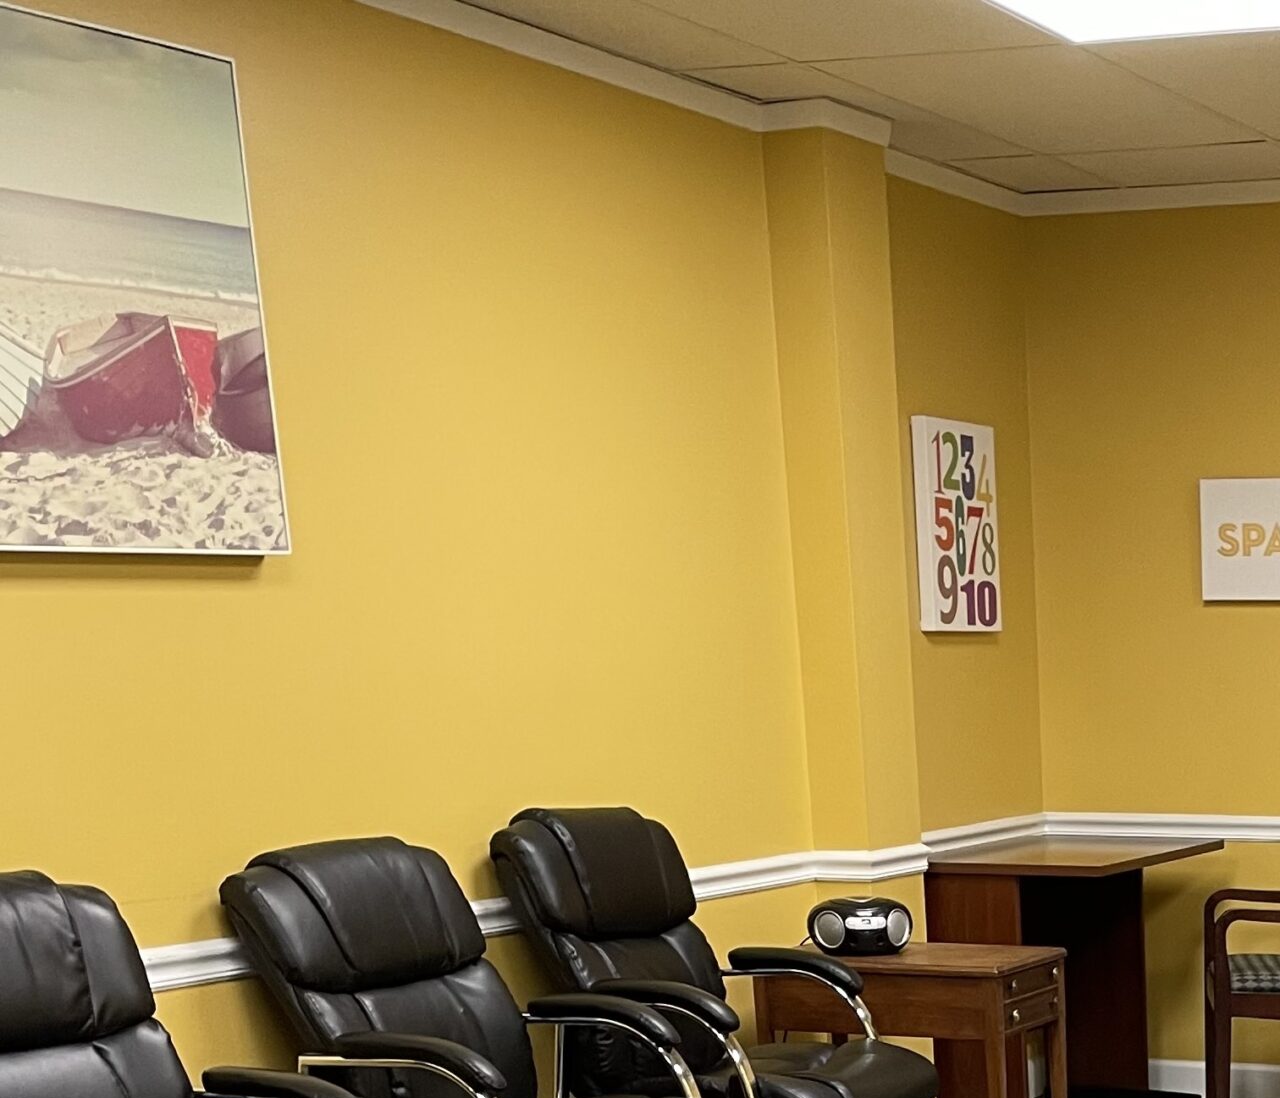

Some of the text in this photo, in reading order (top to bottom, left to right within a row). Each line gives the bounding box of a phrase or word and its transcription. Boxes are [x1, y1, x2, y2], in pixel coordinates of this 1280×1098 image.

[931, 430, 993, 517] 1 2 3 4
[935, 495, 996, 576] 5 6 7 8
[938, 554, 997, 627] 9 10
